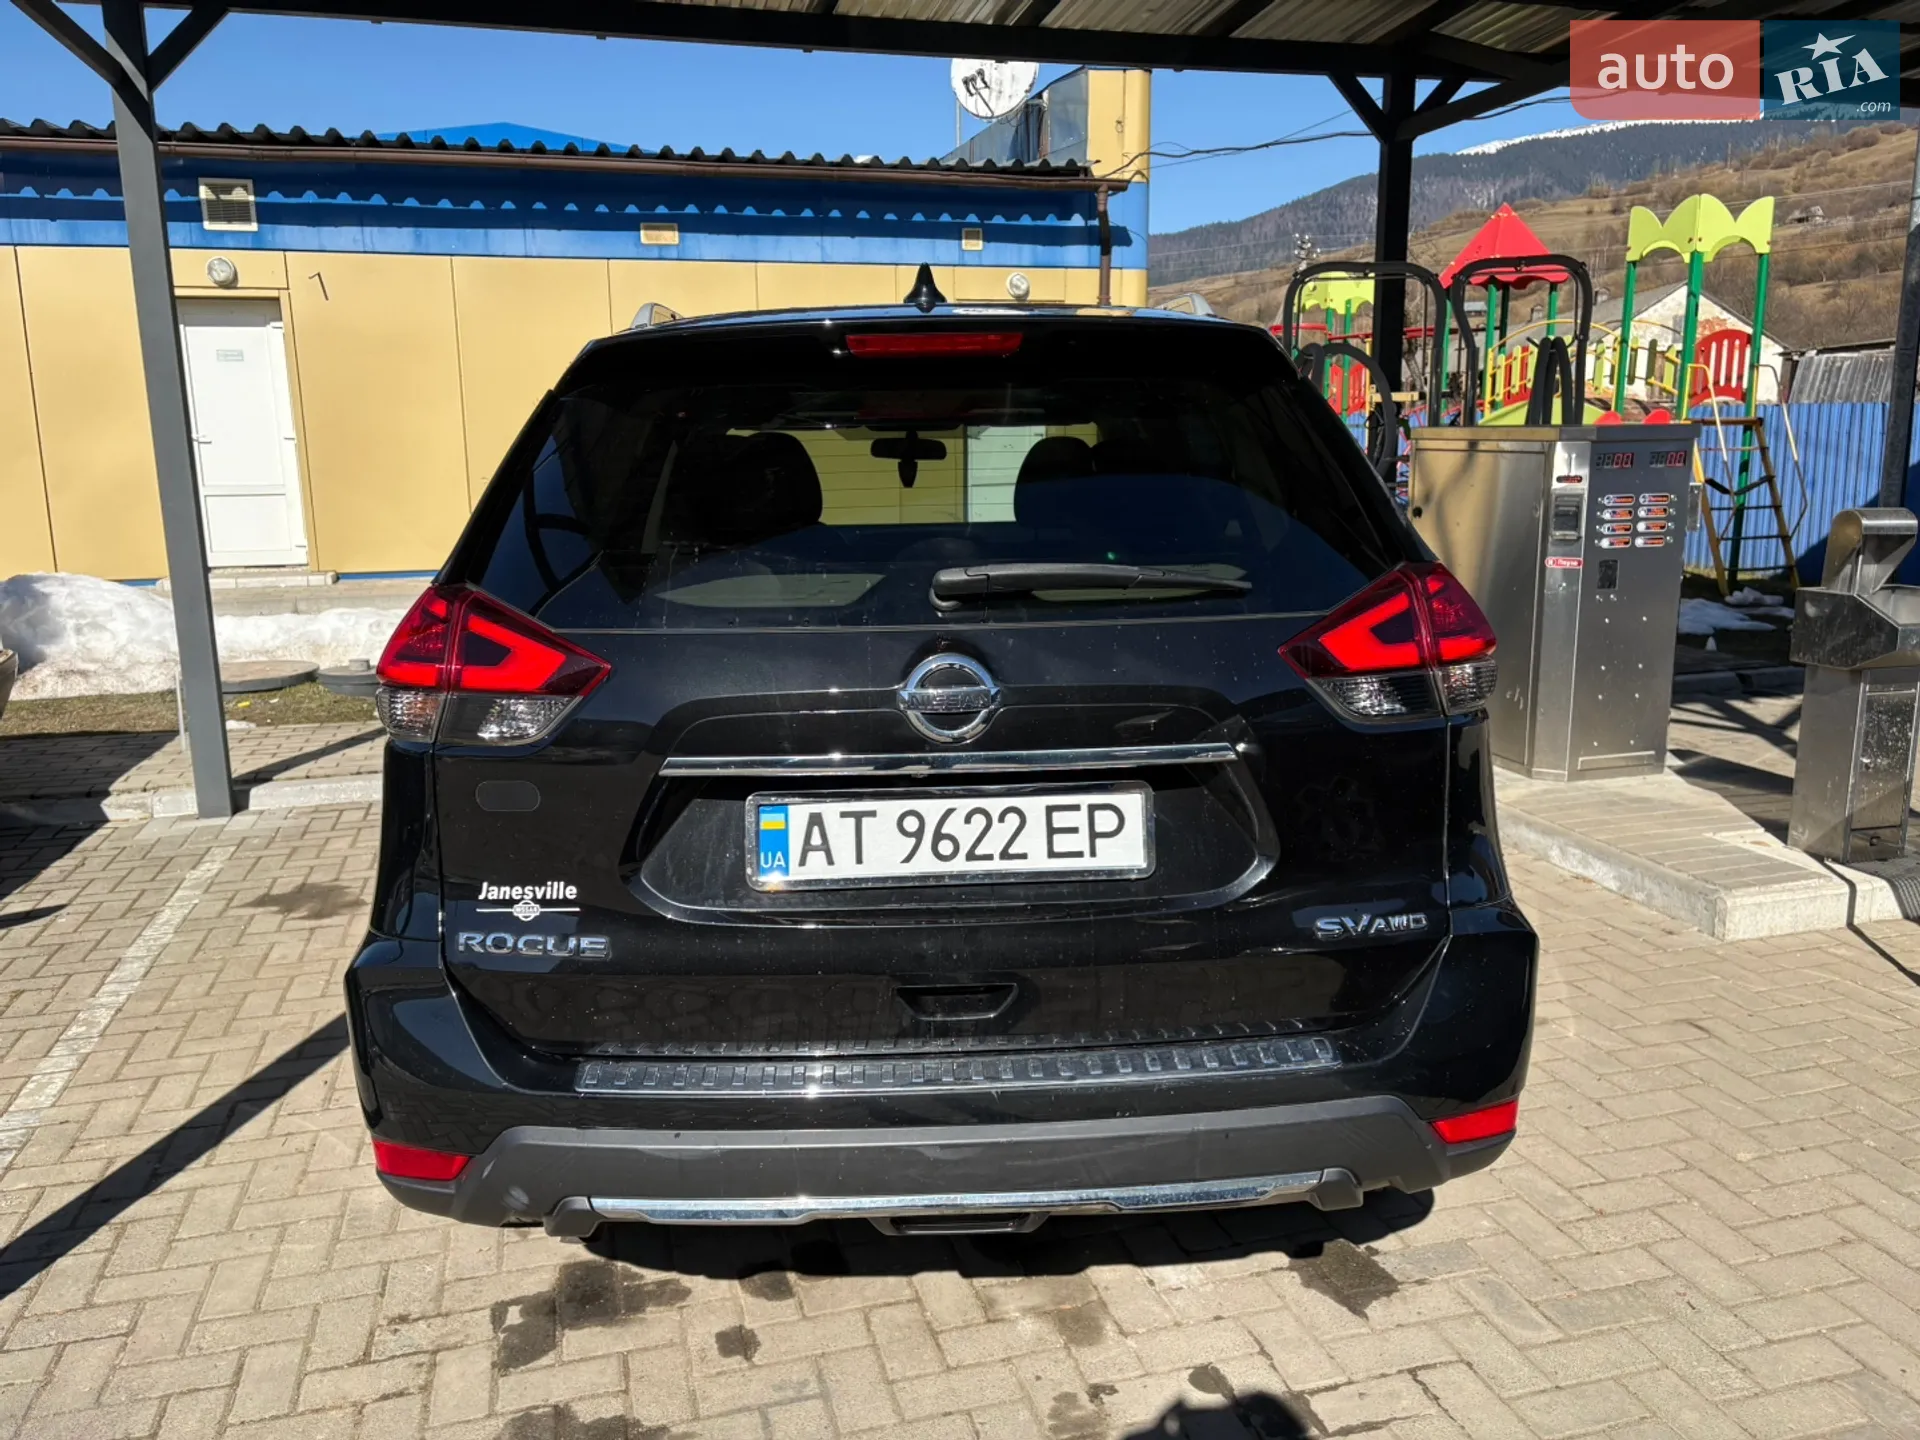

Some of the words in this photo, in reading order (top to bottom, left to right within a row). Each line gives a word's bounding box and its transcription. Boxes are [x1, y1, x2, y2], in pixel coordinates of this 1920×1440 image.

[908, 693, 989, 709] NISSAN
[798, 810, 877, 867] AT
[896, 805, 1028, 865] 9622
[1045, 802, 1126, 859] EP
[760, 850, 786, 868] UA
[478, 881, 578, 901] Janesville
[1316, 914, 1371, 940] SV
[1368, 912, 1428, 935] AWD
[457, 931, 608, 958] ROGUE
